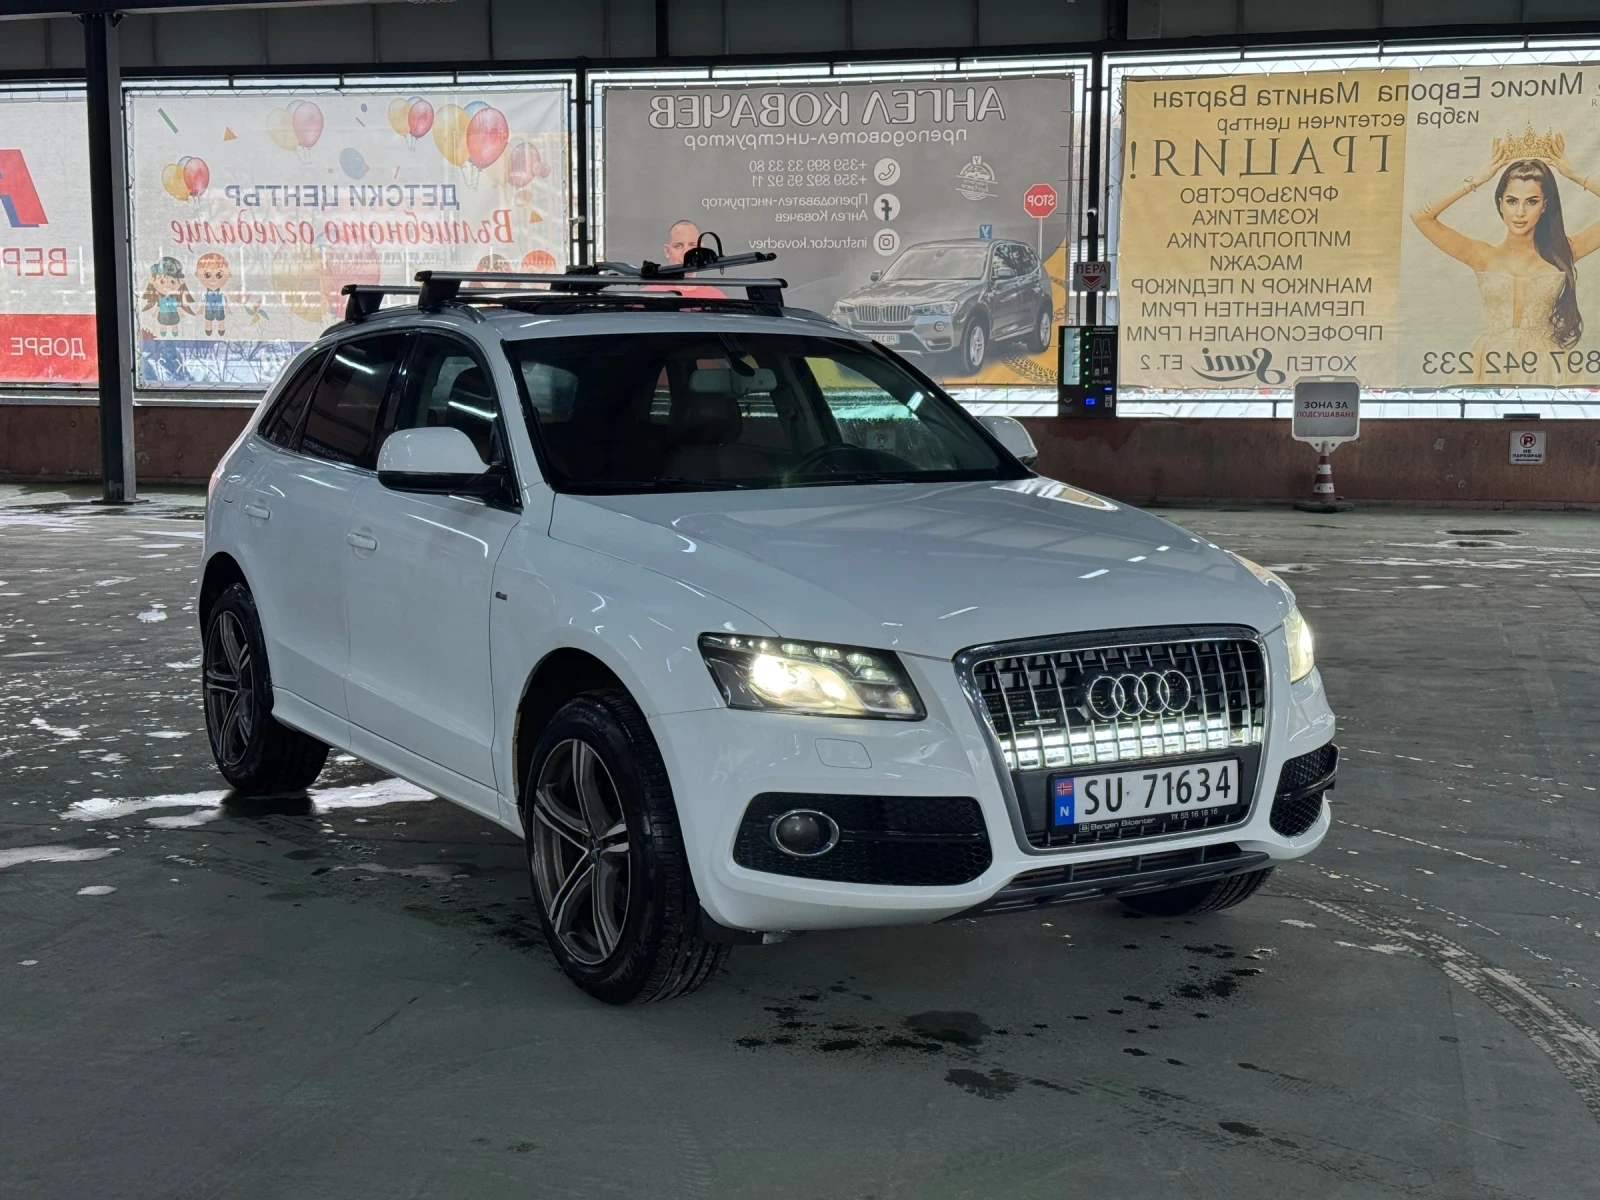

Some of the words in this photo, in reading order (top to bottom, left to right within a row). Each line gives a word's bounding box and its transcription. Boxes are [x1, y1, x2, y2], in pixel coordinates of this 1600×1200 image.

[1076, 263, 1107, 275] ПЕРА
[1304, 401, 1333, 409] ЗОНА
[1334, 401, 1348, 409] ЗА
[1084, 776, 1123, 815] SU
[1143, 765, 1231, 809] 71634
[1090, 821, 1119, 831] Bergen
[1121, 817, 1156, 827] Bilcenter
[1180, 811, 1189, 819] 55
[1190, 810, 1199, 818] 16
[1200, 809, 1209, 817] 16
[1210, 807, 1218, 815] 16
